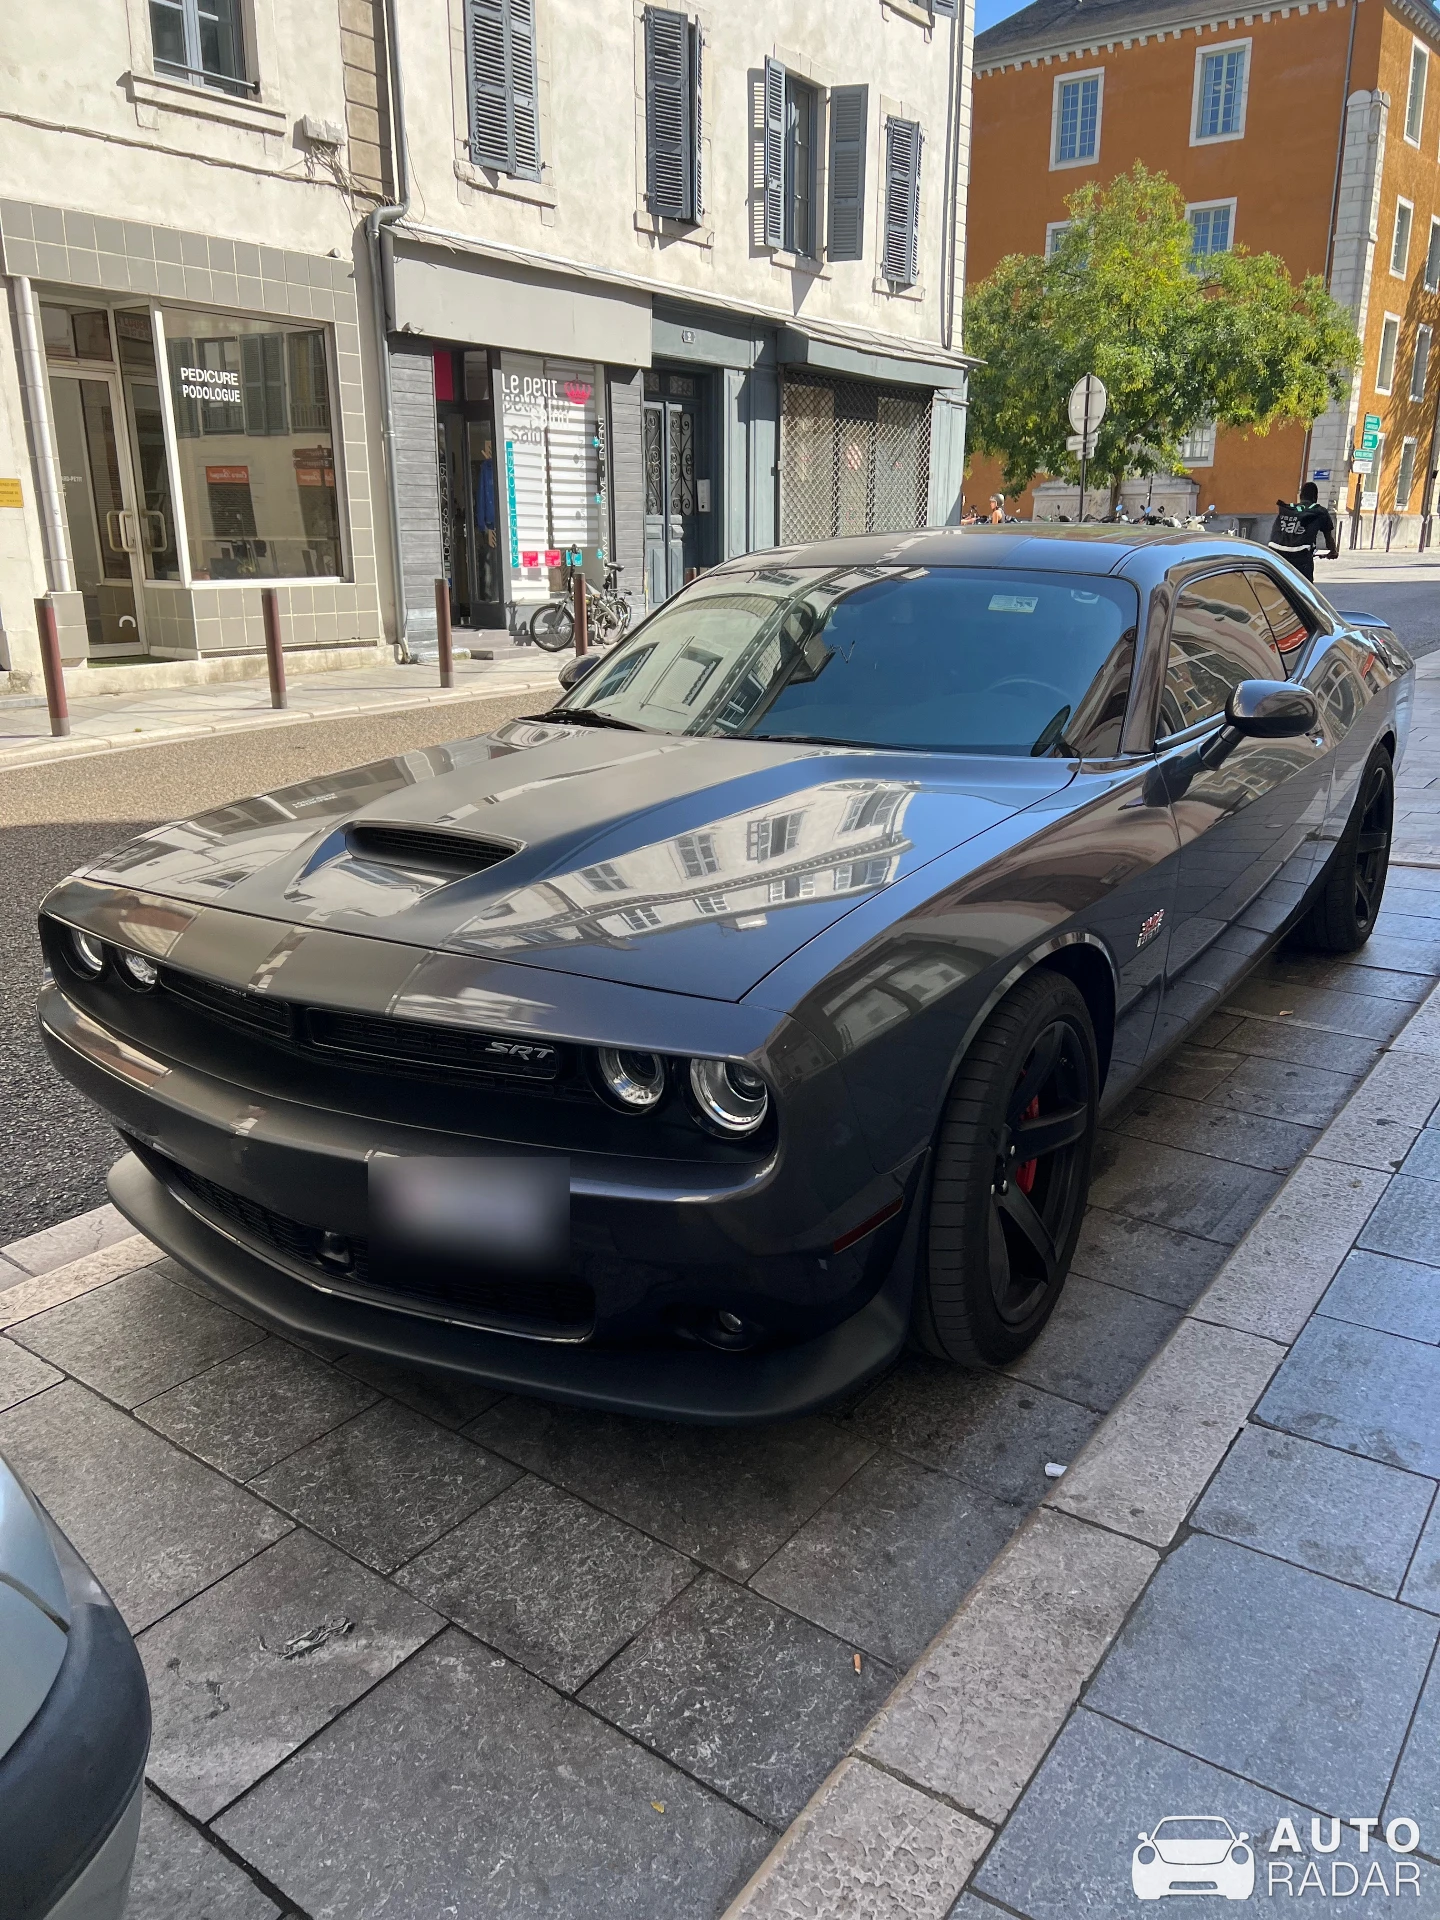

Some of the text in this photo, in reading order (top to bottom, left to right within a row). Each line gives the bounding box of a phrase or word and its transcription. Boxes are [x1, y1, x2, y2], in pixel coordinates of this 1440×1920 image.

[180, 367, 239, 386] PEDICURE
[182, 384, 241, 403] PODOLOGUE
[524, 376, 558, 400] petit
[597, 415, 605, 461] ENFANT
[485, 1041, 555, 1061] SRT
